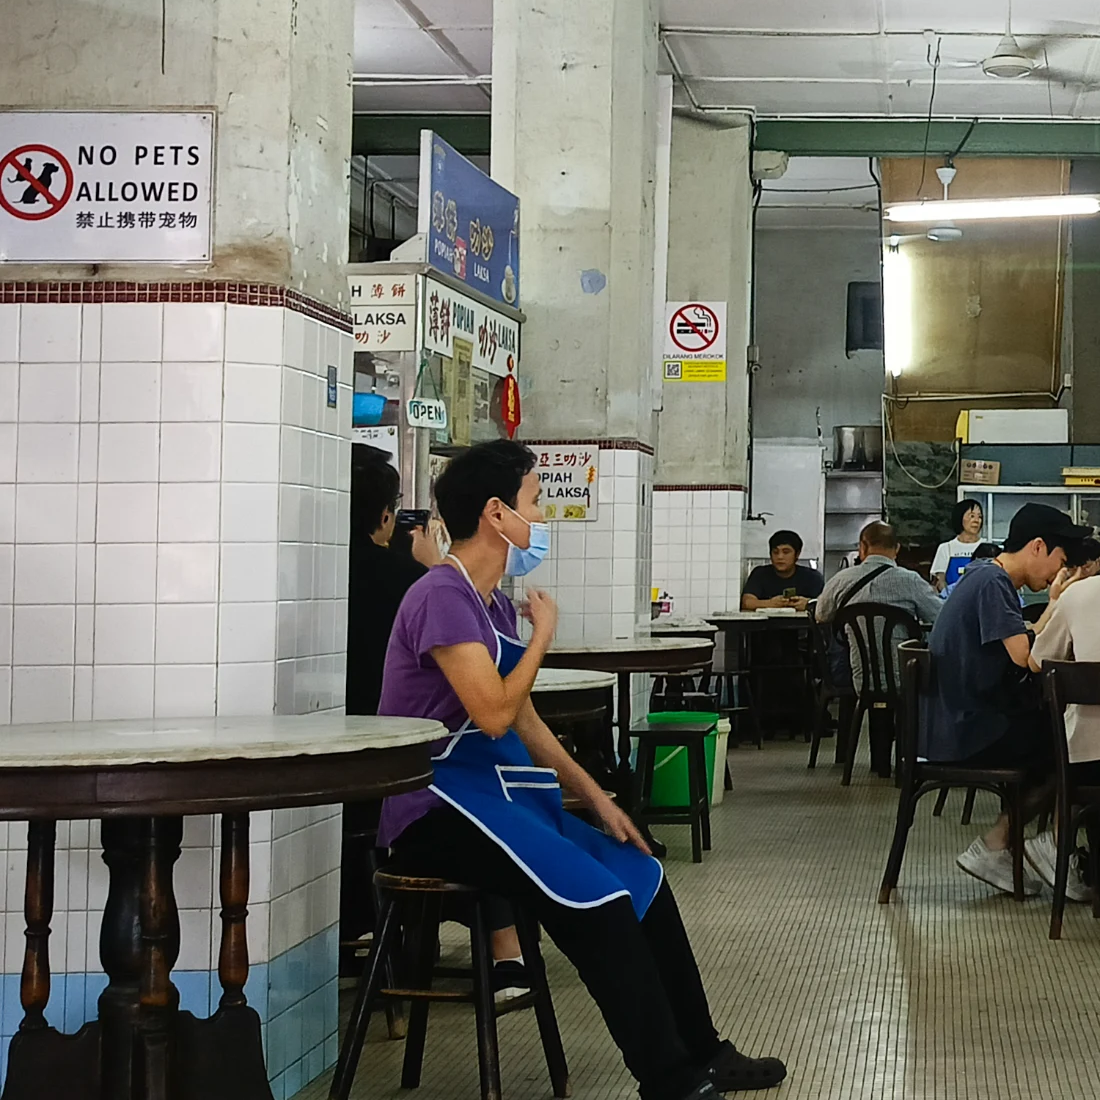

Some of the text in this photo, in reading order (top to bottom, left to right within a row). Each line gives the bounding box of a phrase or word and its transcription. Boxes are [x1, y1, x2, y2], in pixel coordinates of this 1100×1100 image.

[78, 146, 200, 165] NO PETS
[76, 182, 199, 202] ALLOWED
[76, 211, 198, 229] 禁止携带宠物
[353, 313, 407, 325] LAKSA
[453, 302, 475, 335] POPIAH
[413, 404, 442, 421] OPEN
[547, 487, 590, 498] LAKSA
